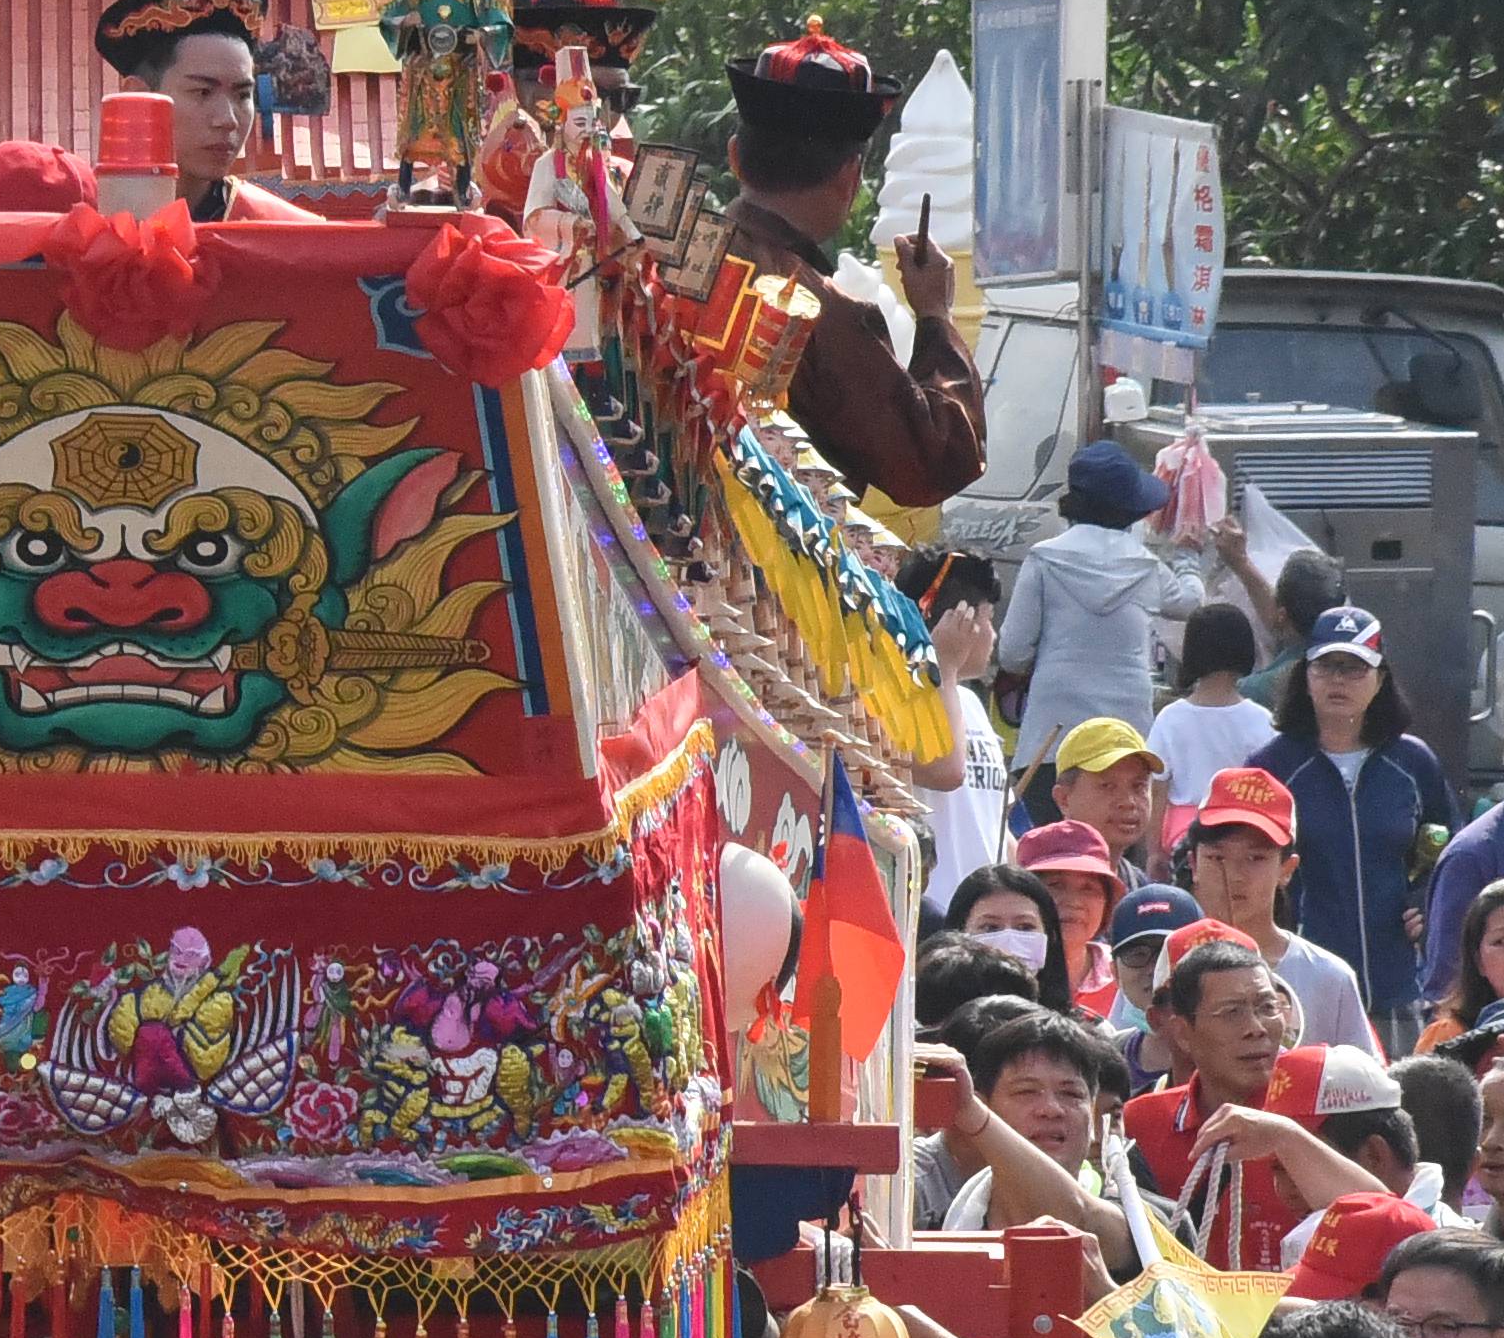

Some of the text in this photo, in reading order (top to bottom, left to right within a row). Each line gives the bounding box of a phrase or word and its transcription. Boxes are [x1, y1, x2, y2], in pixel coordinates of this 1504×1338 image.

[1192, 145, 1215, 327] 優格霜淇淋
